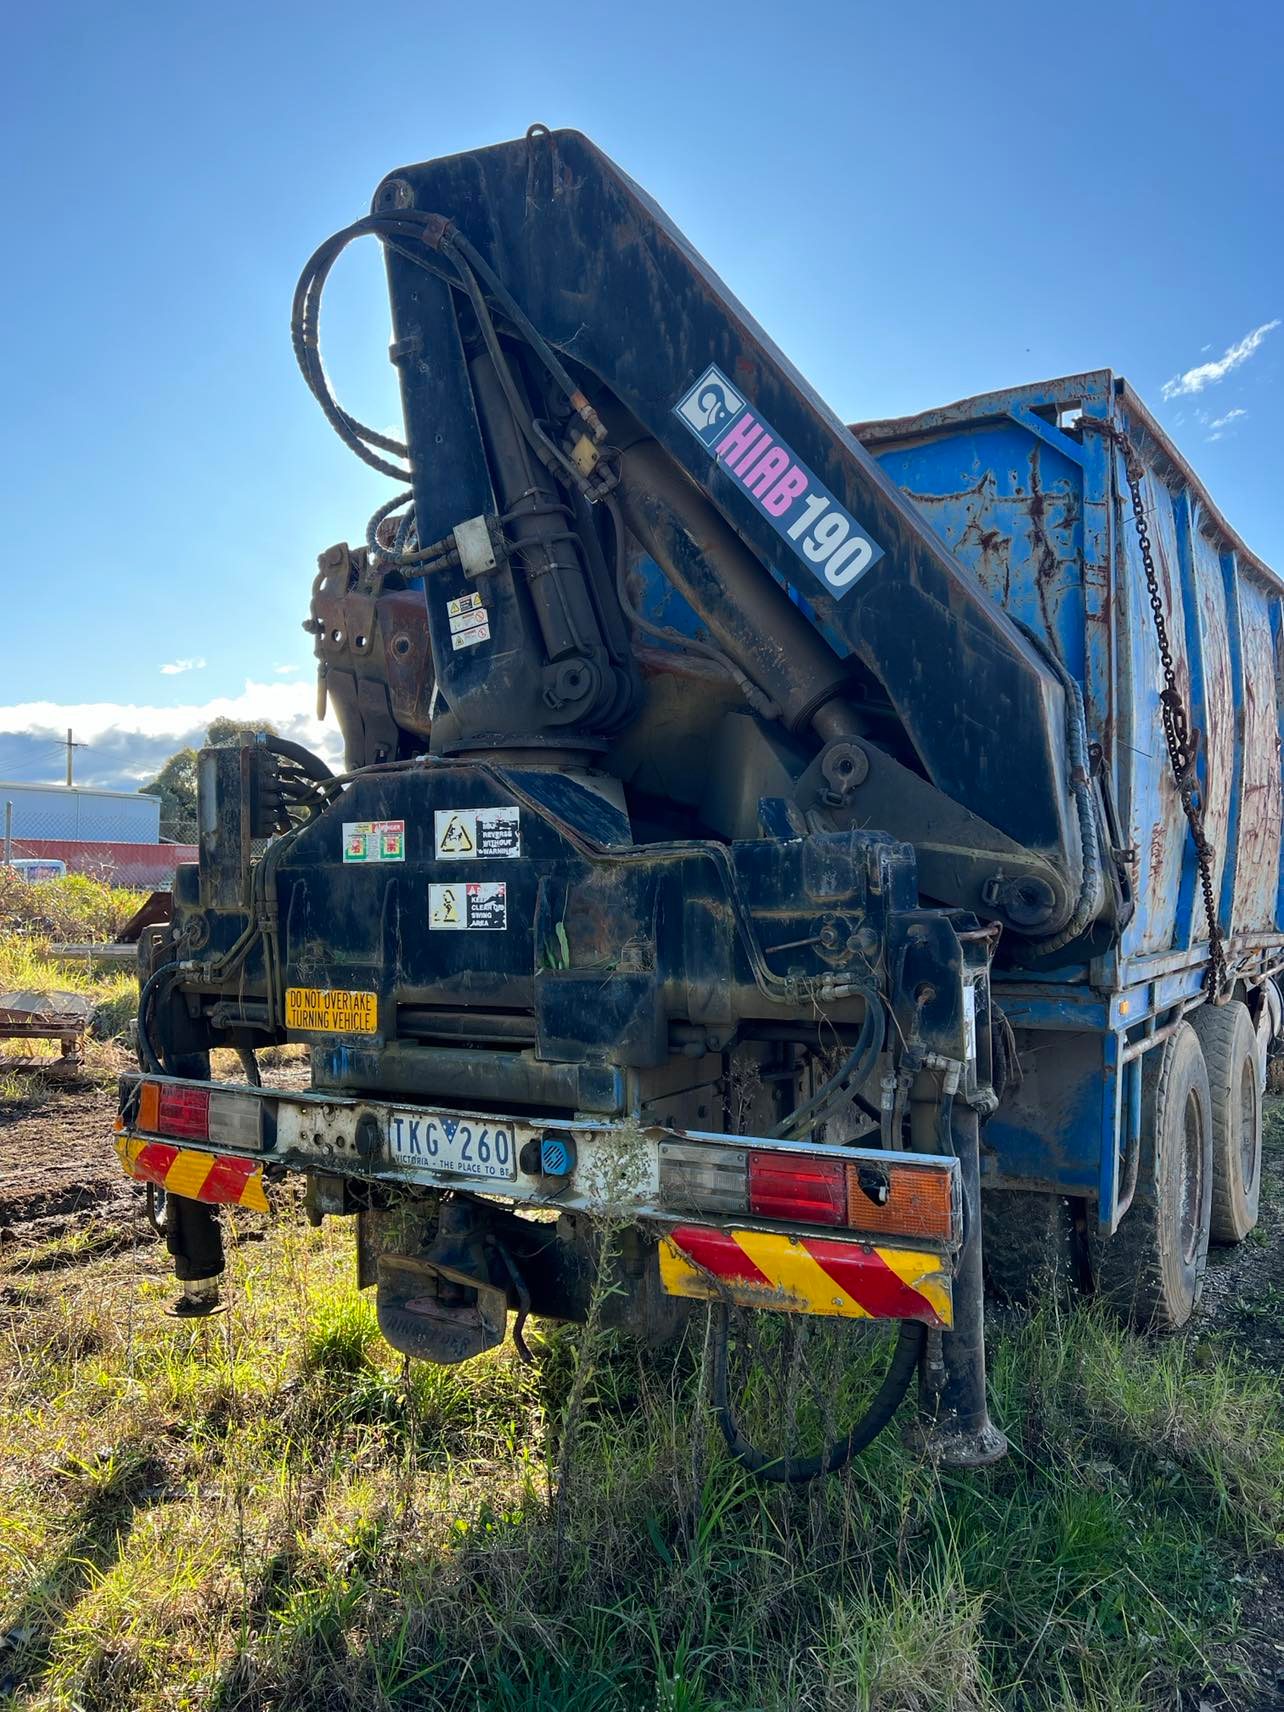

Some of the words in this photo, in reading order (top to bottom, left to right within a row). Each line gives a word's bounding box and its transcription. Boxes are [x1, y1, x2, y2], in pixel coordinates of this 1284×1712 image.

[715, 412, 808, 517] HIAB
[787, 494, 872, 586] 190
[290, 991, 302, 1008] DO
[304, 991, 320, 1009] NOT
[324, 992, 372, 1012] OVERTAKE
[292, 1010, 329, 1029] TURNING
[332, 1012, 371, 1031] VEHICLE
[393, 1118, 439, 1157] TKG
[459, 1126, 509, 1165] 260
[395, 1154, 429, 1167] VICTORIA
[440, 1160, 454, 1169] THE
[457, 1163, 481, 1174] PLACE
[484, 1165, 496, 1175] TO
